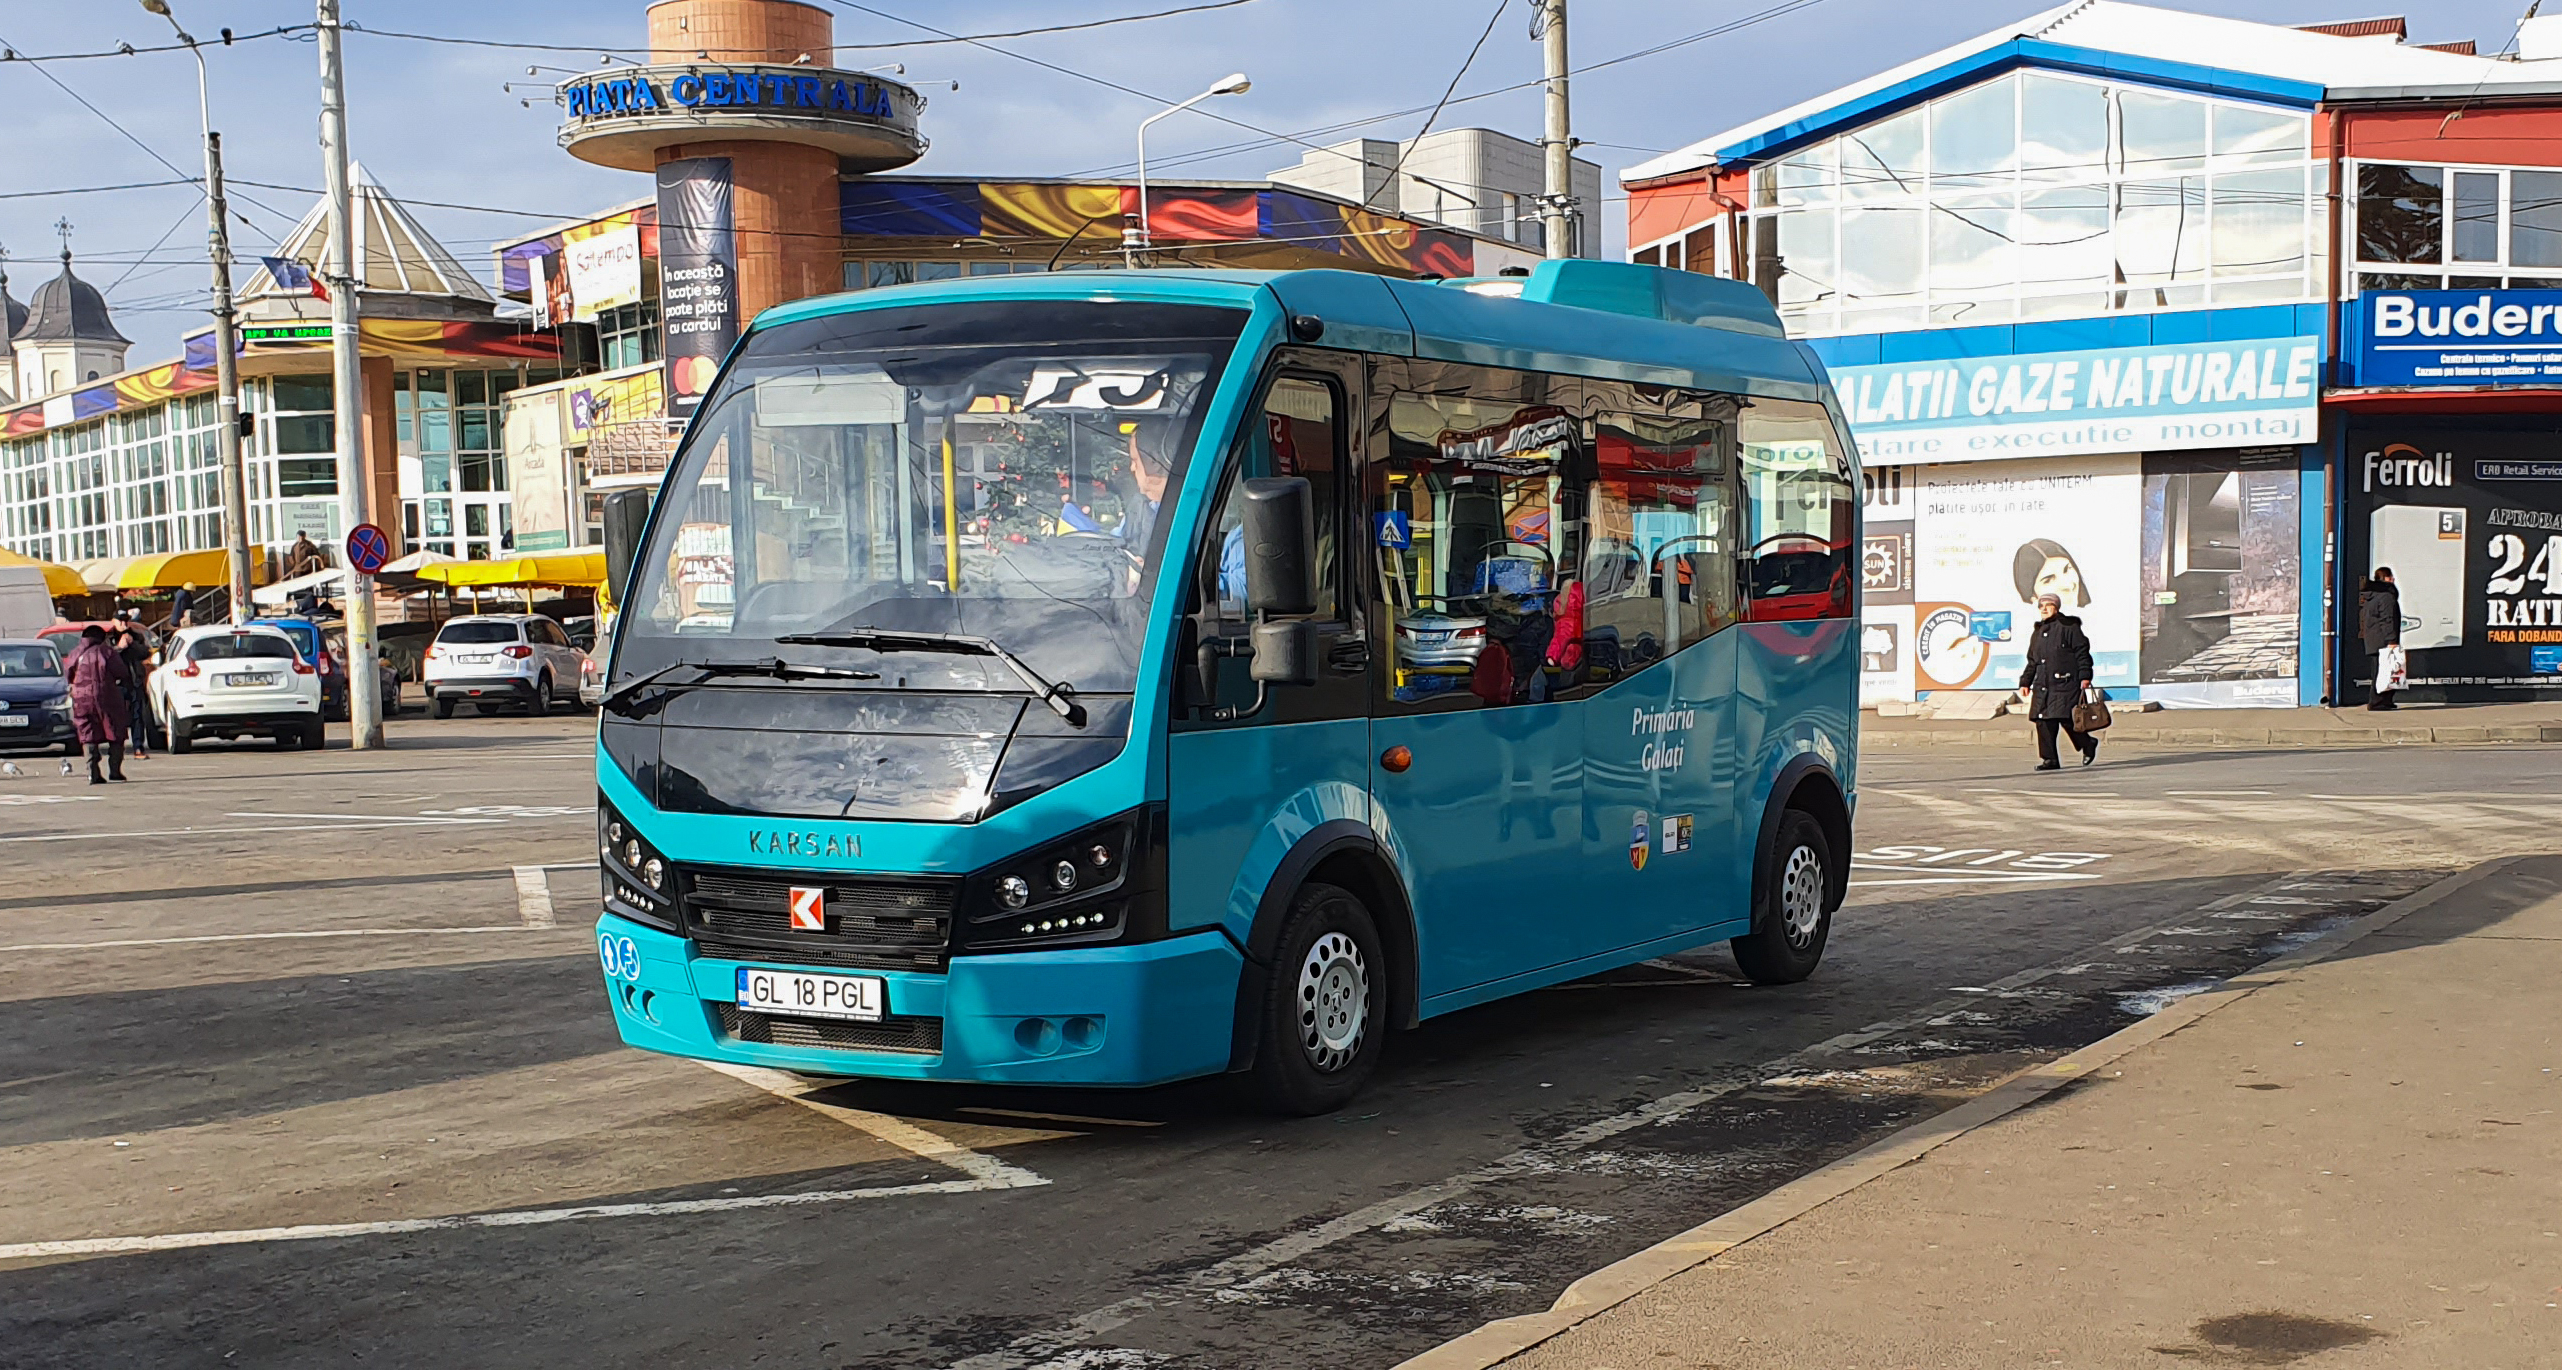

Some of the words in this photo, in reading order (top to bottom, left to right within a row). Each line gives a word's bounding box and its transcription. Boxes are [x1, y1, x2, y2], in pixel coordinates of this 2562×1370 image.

[671, 73, 894, 119] CENTRALA
[704, 284, 721, 296] se
[681, 316, 721, 333] cardul
[2374, 295, 2562, 337] Buder
[1968, 359, 2080, 417] GAZE
[2086, 346, 2317, 410] NATURALE
[1967, 424, 2133, 451] executie
[2160, 414, 2302, 441] montaj
[2040, 474, 2092, 489] UNITERM
[2363, 451, 2453, 492] Ferroli
[2442, 514, 2453, 531] 5
[1864, 559, 1885, 570] SUN
[2486, 534, 2562, 596] 24
[2487, 629, 2516, 643] FARA
[1631, 702, 1695, 735] Primăria
[1641, 738, 1684, 774] Galați
[749, 829, 862, 859] KARSAN
[754, 975, 783, 1004] GL
[794, 977, 815, 1006] 18
[823, 979, 874, 1011] PGL
